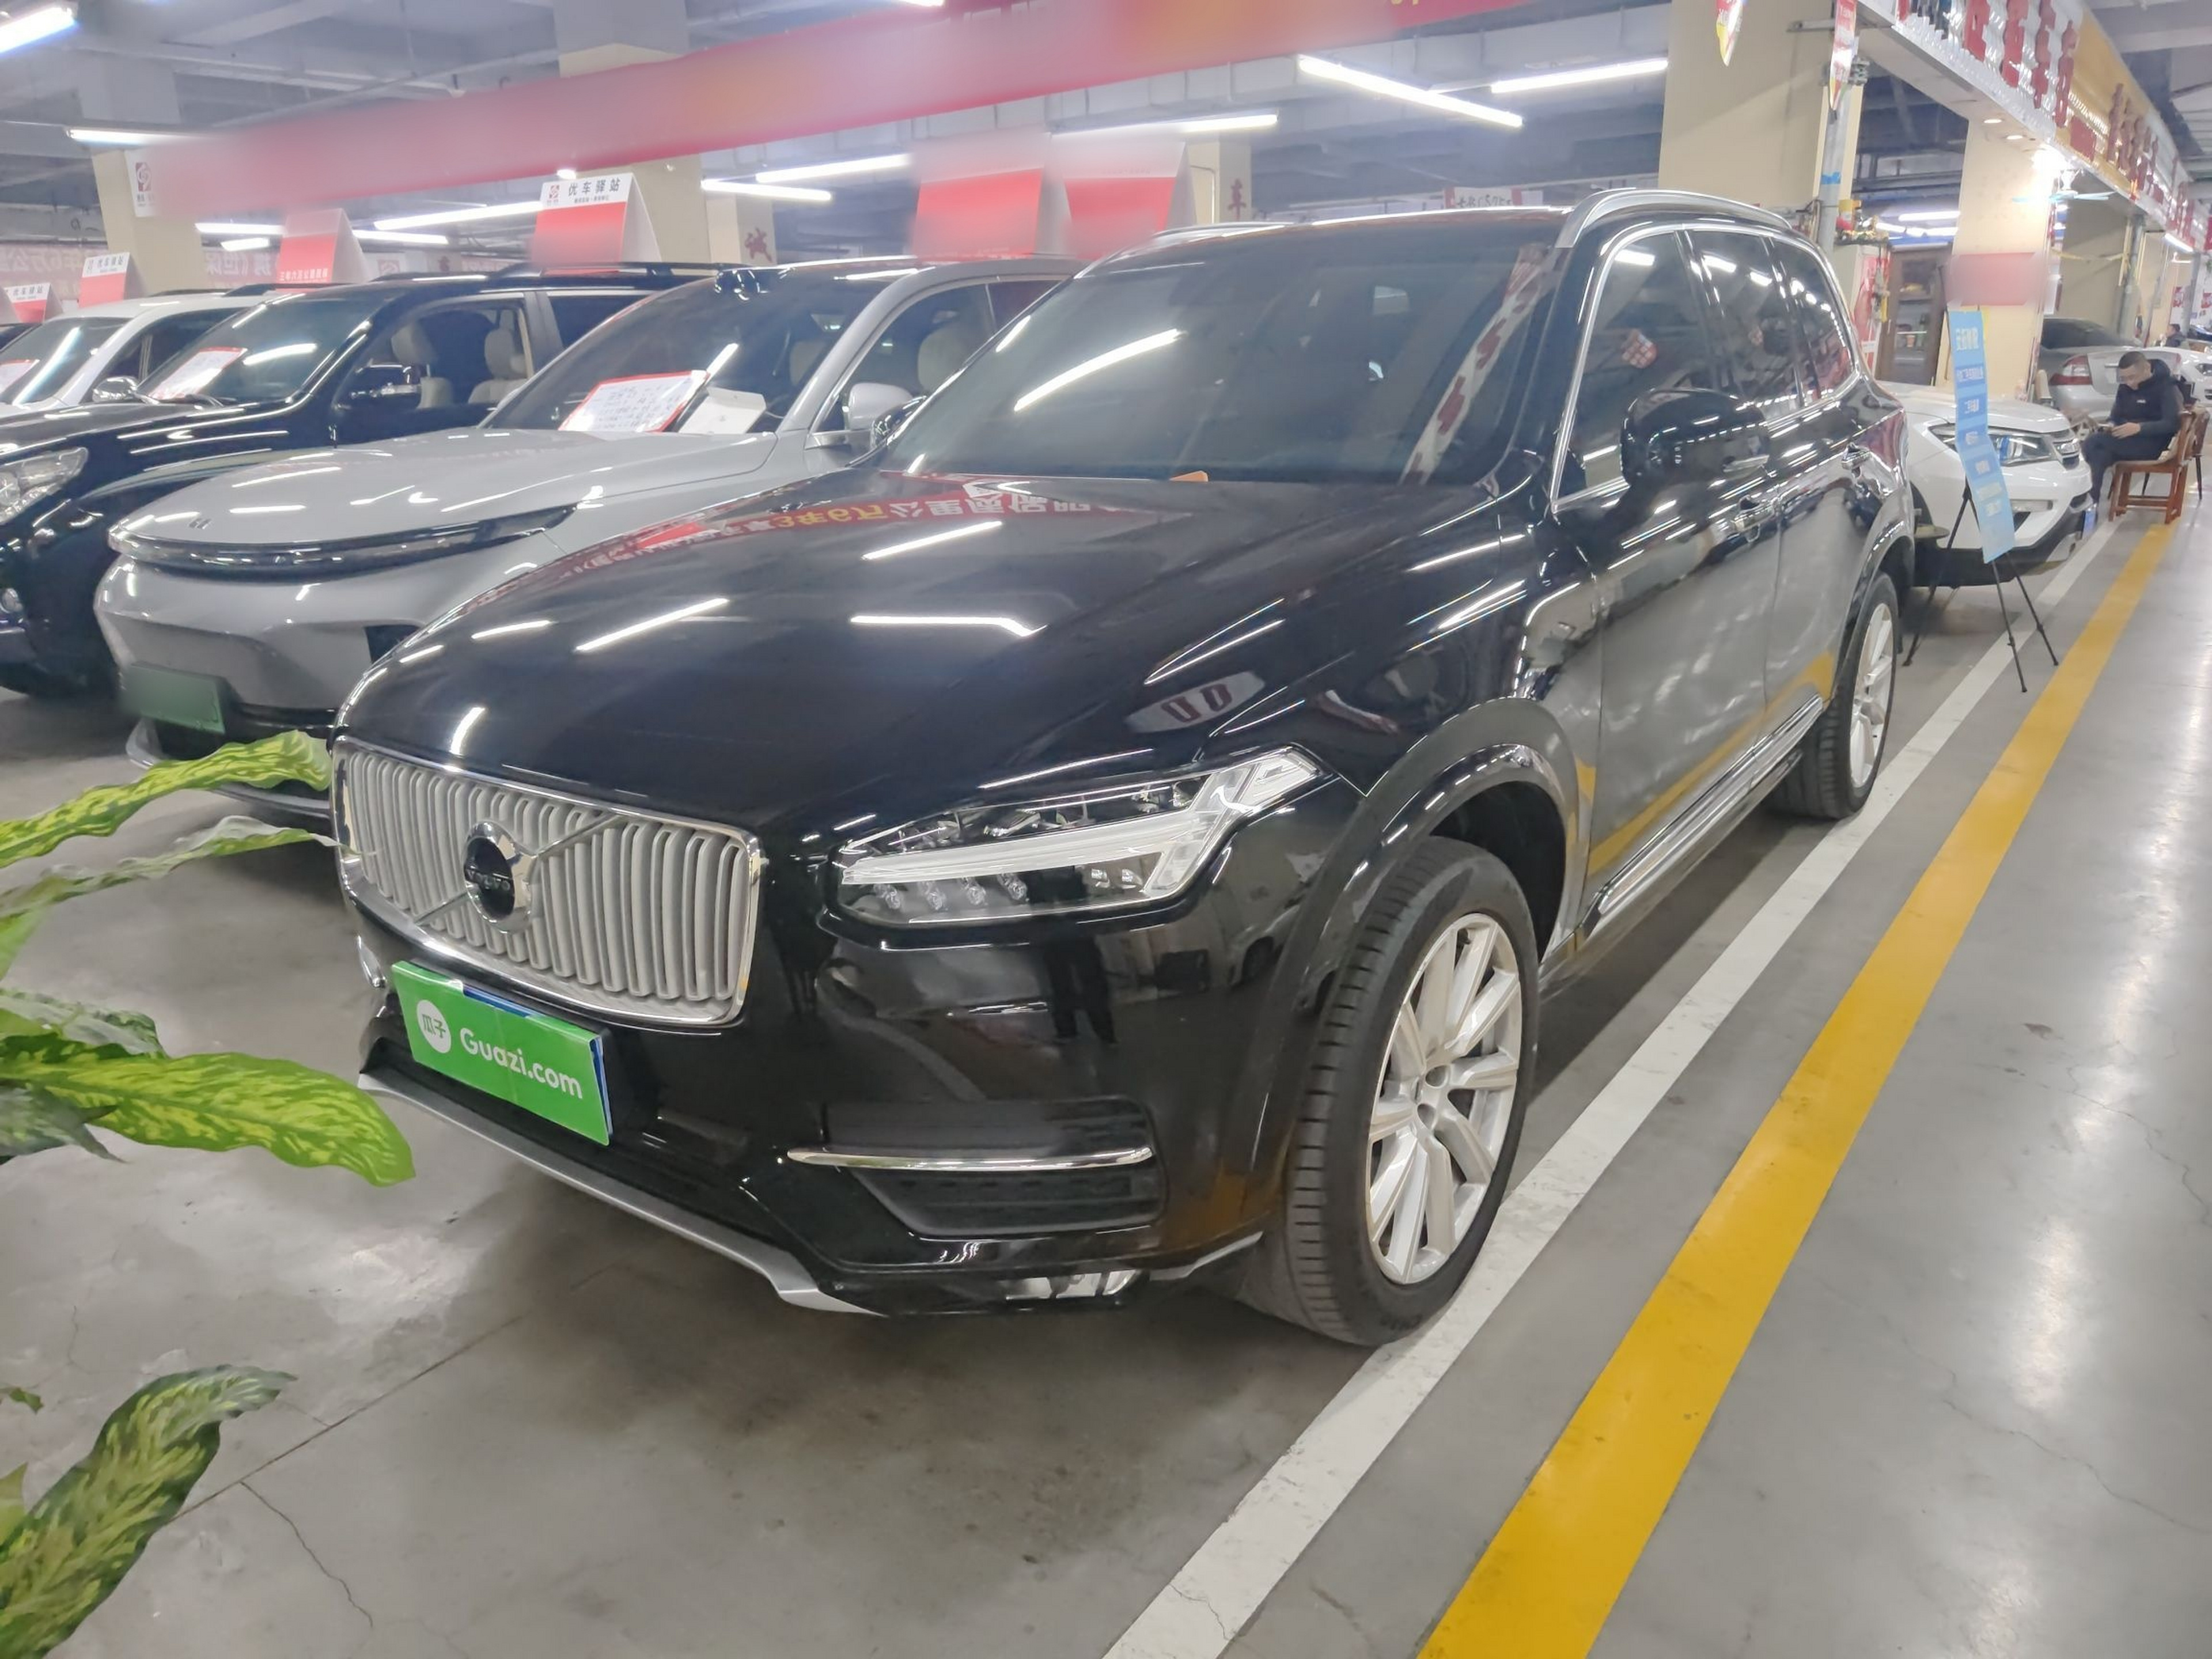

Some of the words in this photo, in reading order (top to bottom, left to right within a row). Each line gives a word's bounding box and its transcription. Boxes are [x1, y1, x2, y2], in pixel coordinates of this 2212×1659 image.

[568, 177, 620, 196] 优车驿站
[422, 1012, 447, 1040] 瓜子
[460, 1027, 584, 1099] Guazi.com
